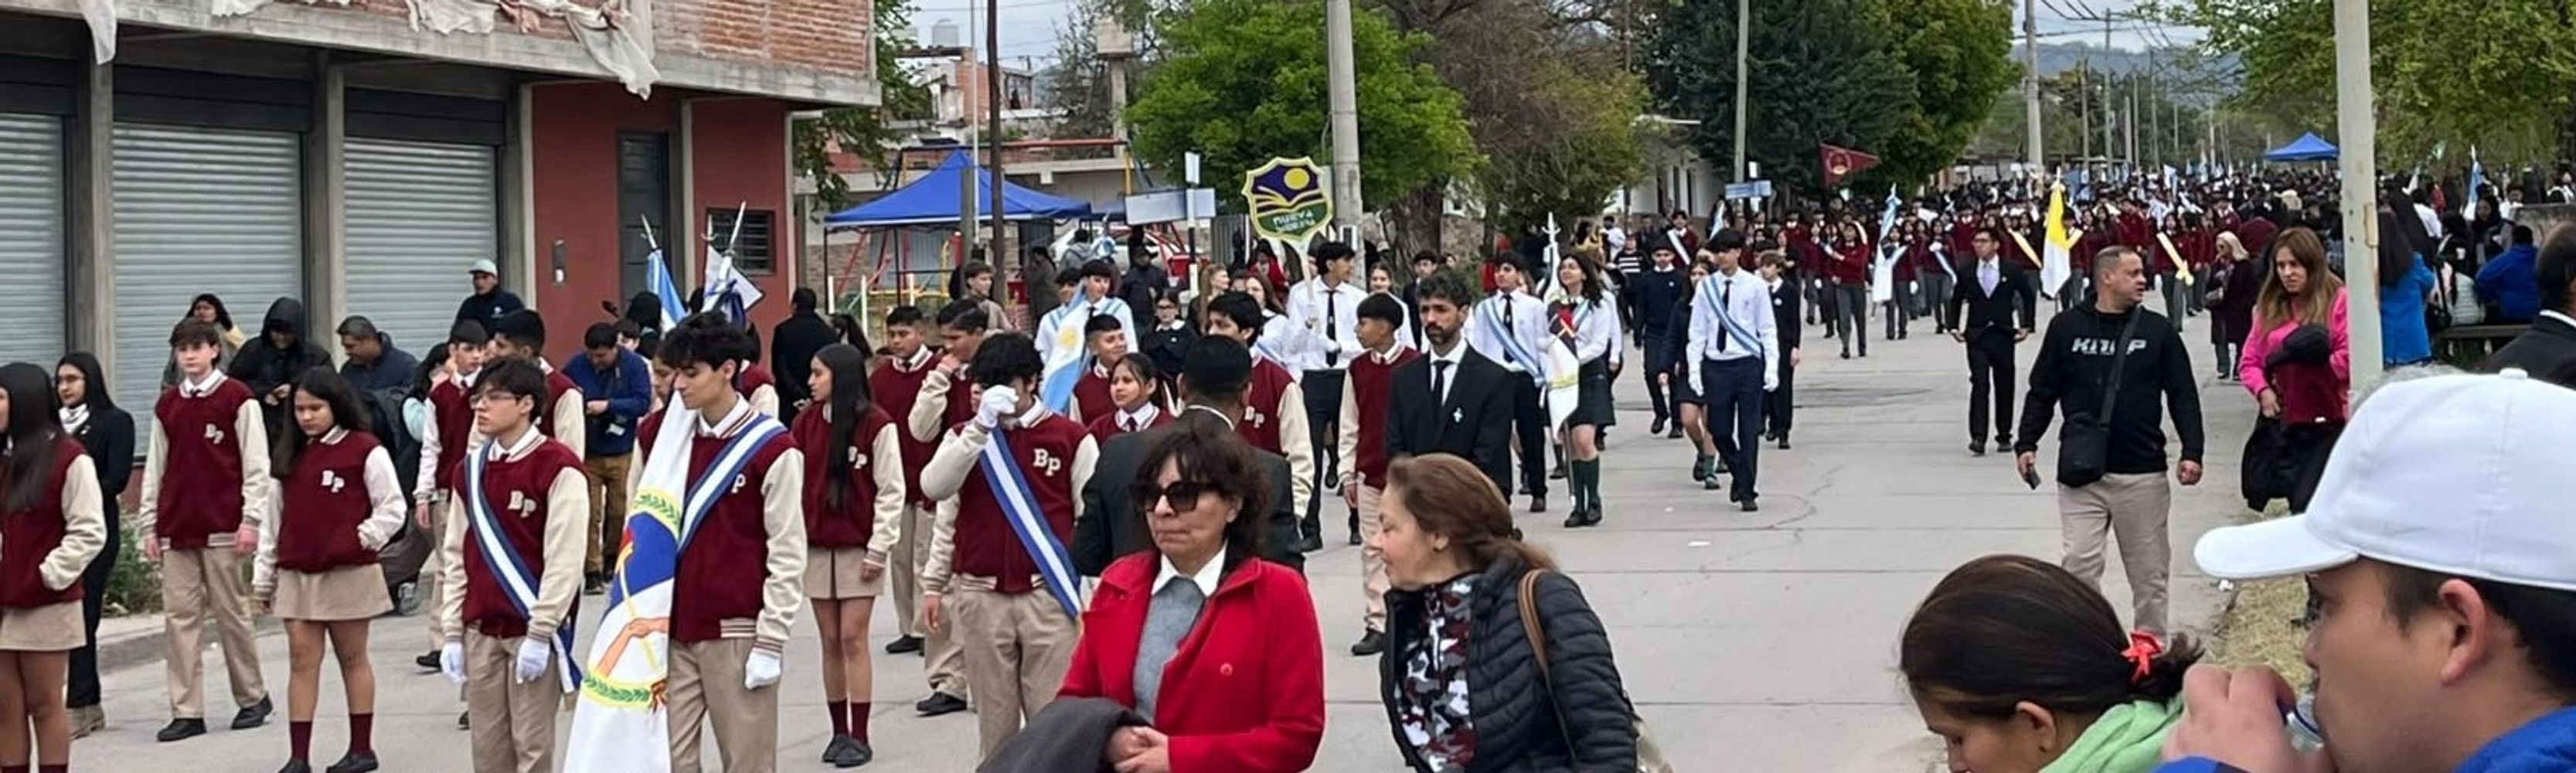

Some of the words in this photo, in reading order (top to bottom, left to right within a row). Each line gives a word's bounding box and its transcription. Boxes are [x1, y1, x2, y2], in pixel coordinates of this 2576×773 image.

[1244, 406, 1265, 428] BP
[1033, 448, 1061, 476] BP
[321, 470, 345, 492] BP
[507, 491, 536, 517] BP
